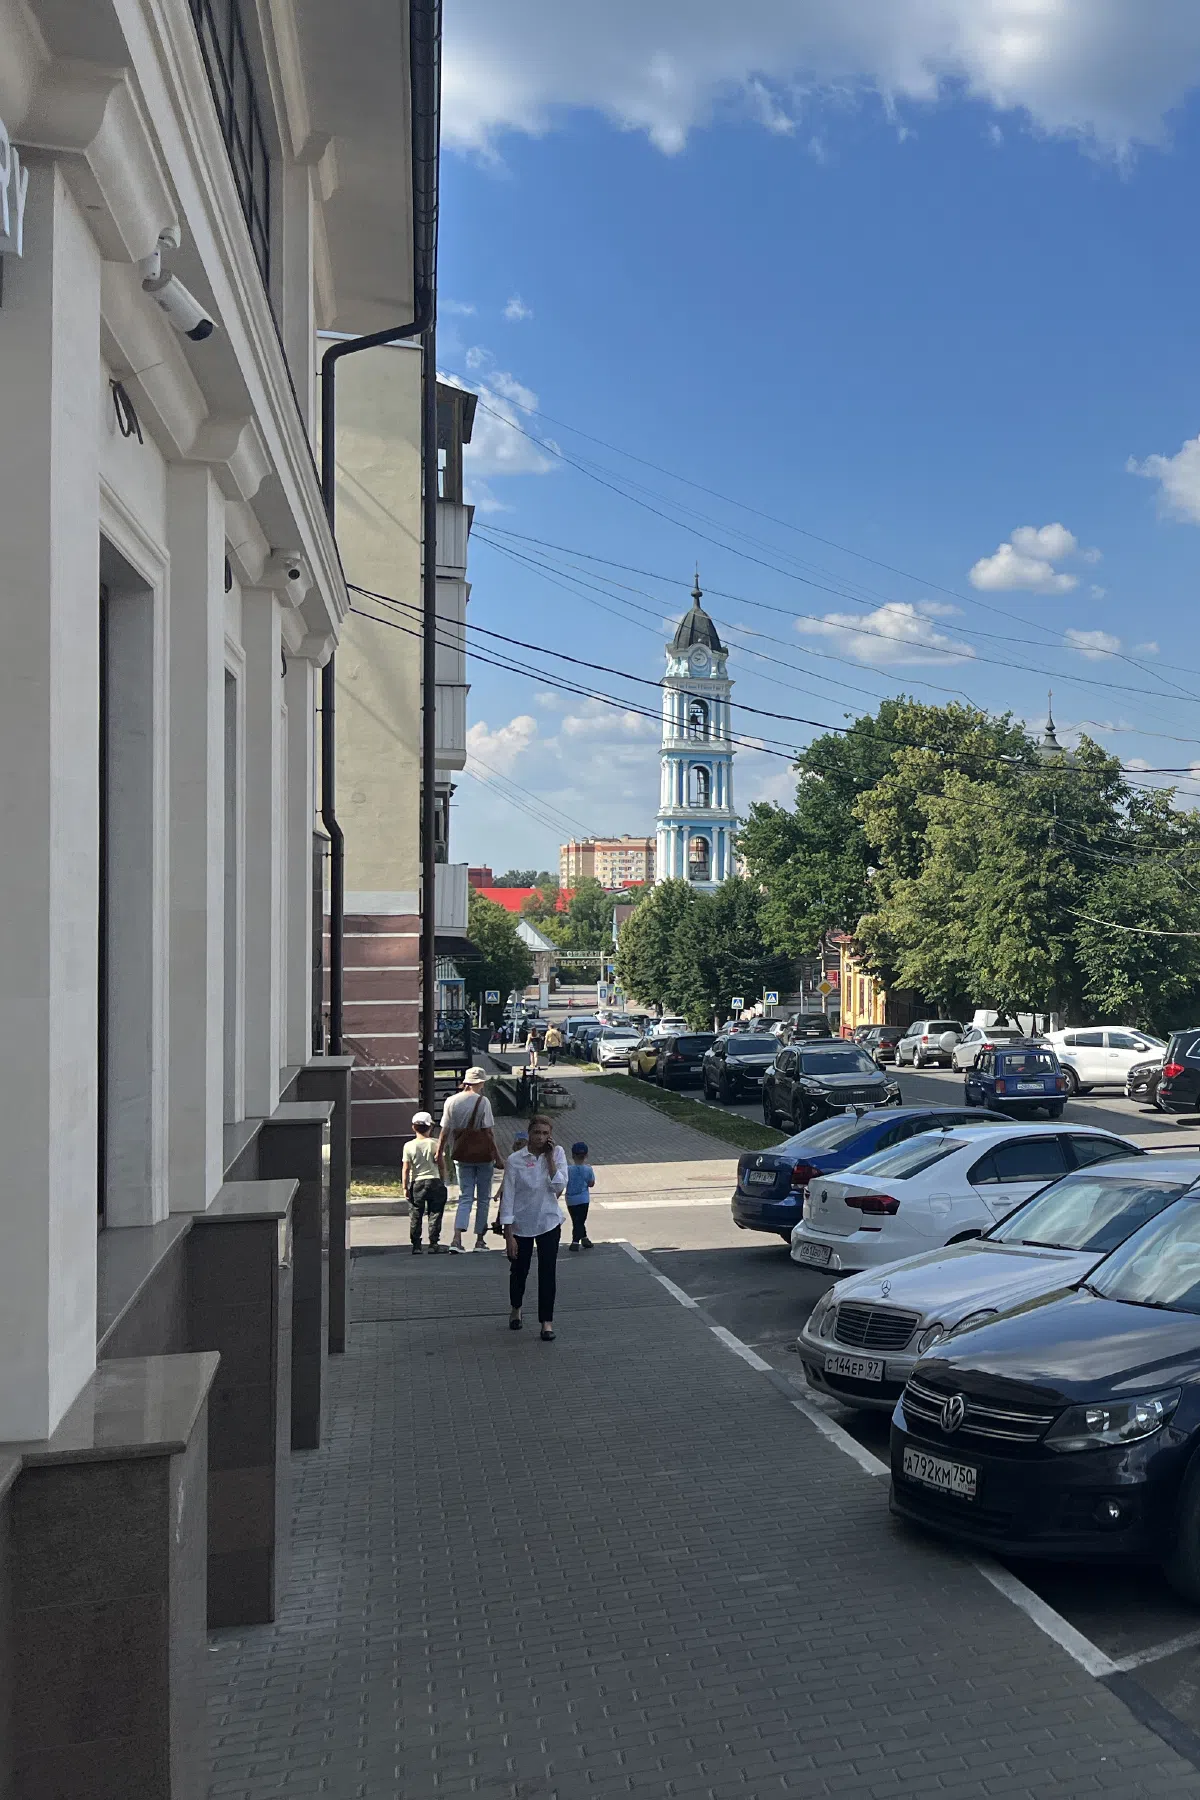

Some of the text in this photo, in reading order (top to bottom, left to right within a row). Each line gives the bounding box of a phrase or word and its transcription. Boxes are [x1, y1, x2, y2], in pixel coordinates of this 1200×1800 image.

[827, 1357, 879, 1376] С144ЕР 97
[907, 1453, 973, 1486] А792КМ 750
